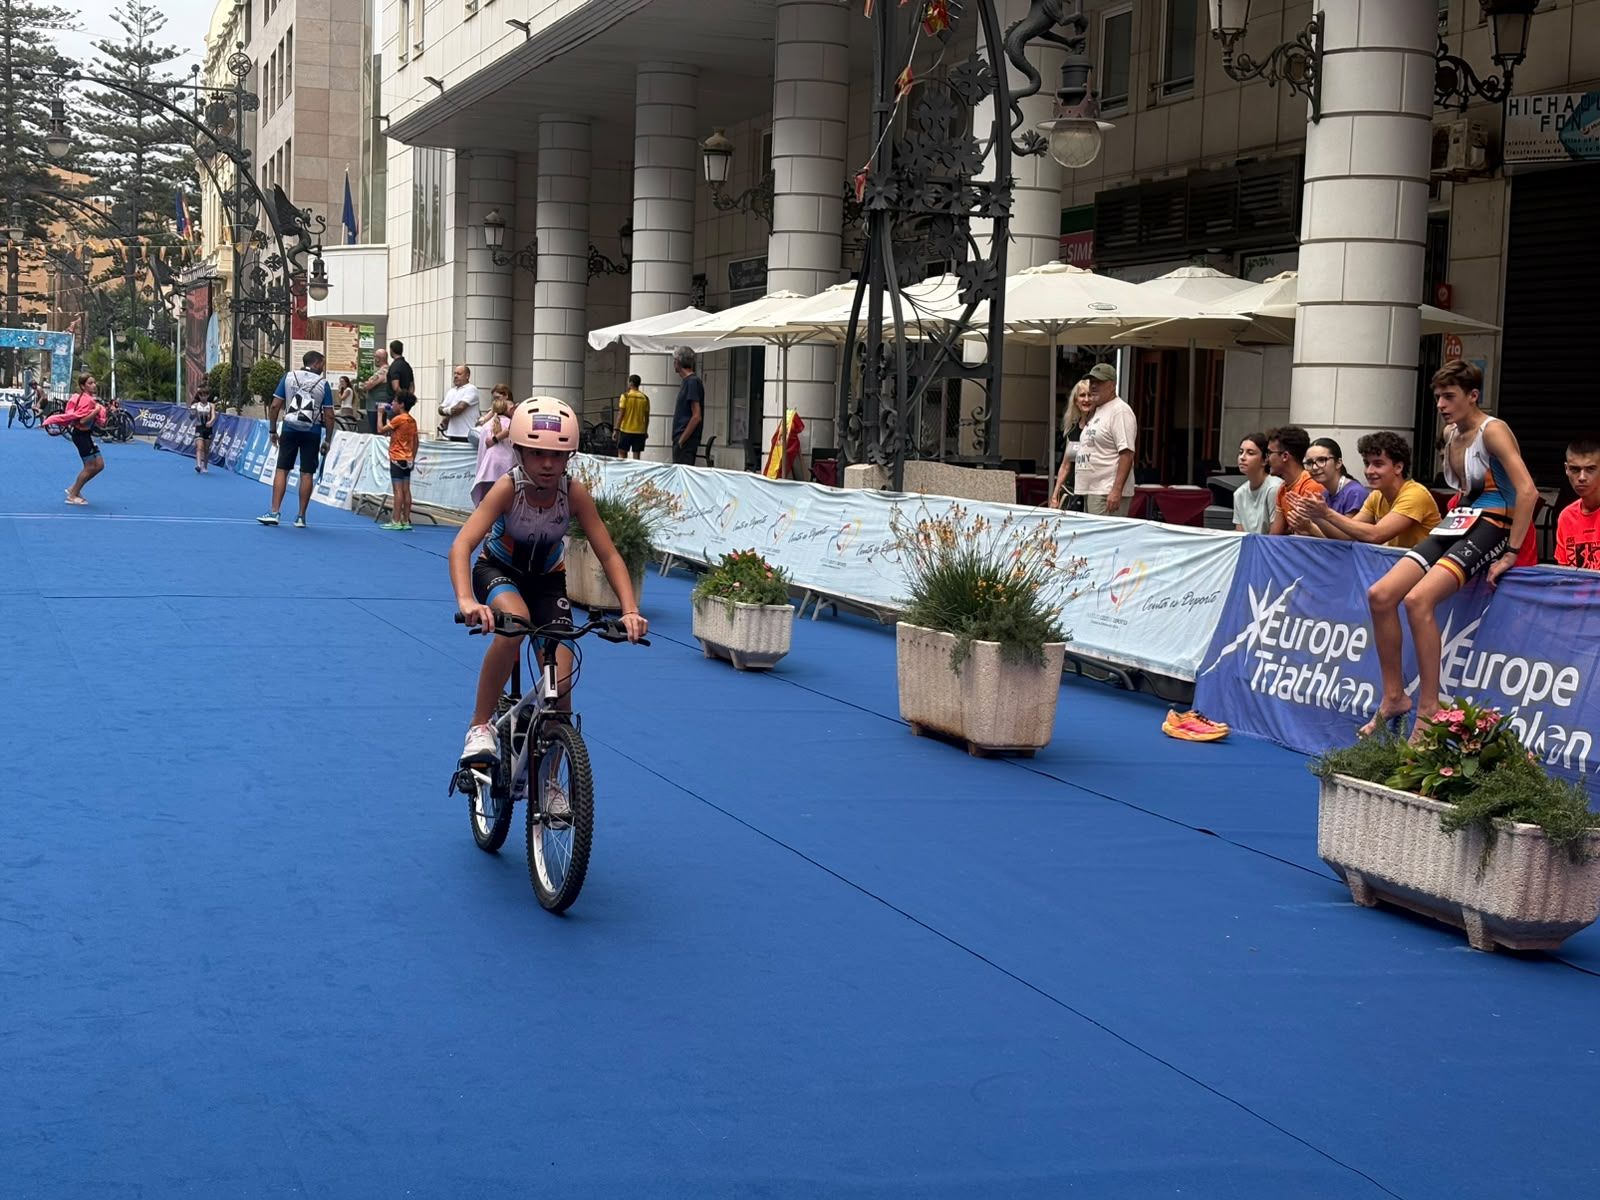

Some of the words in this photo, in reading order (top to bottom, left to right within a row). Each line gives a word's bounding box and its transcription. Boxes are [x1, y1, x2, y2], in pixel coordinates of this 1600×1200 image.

[1540, 113, 1581, 132] FON
[1450, 517, 1466, 528] 57
[1180, 590, 1221, 613] Deporte
[1259, 604, 1369, 663] Europe
[1250, 650, 1375, 719] Triathlon
[1442, 640, 1581, 707] Europe
